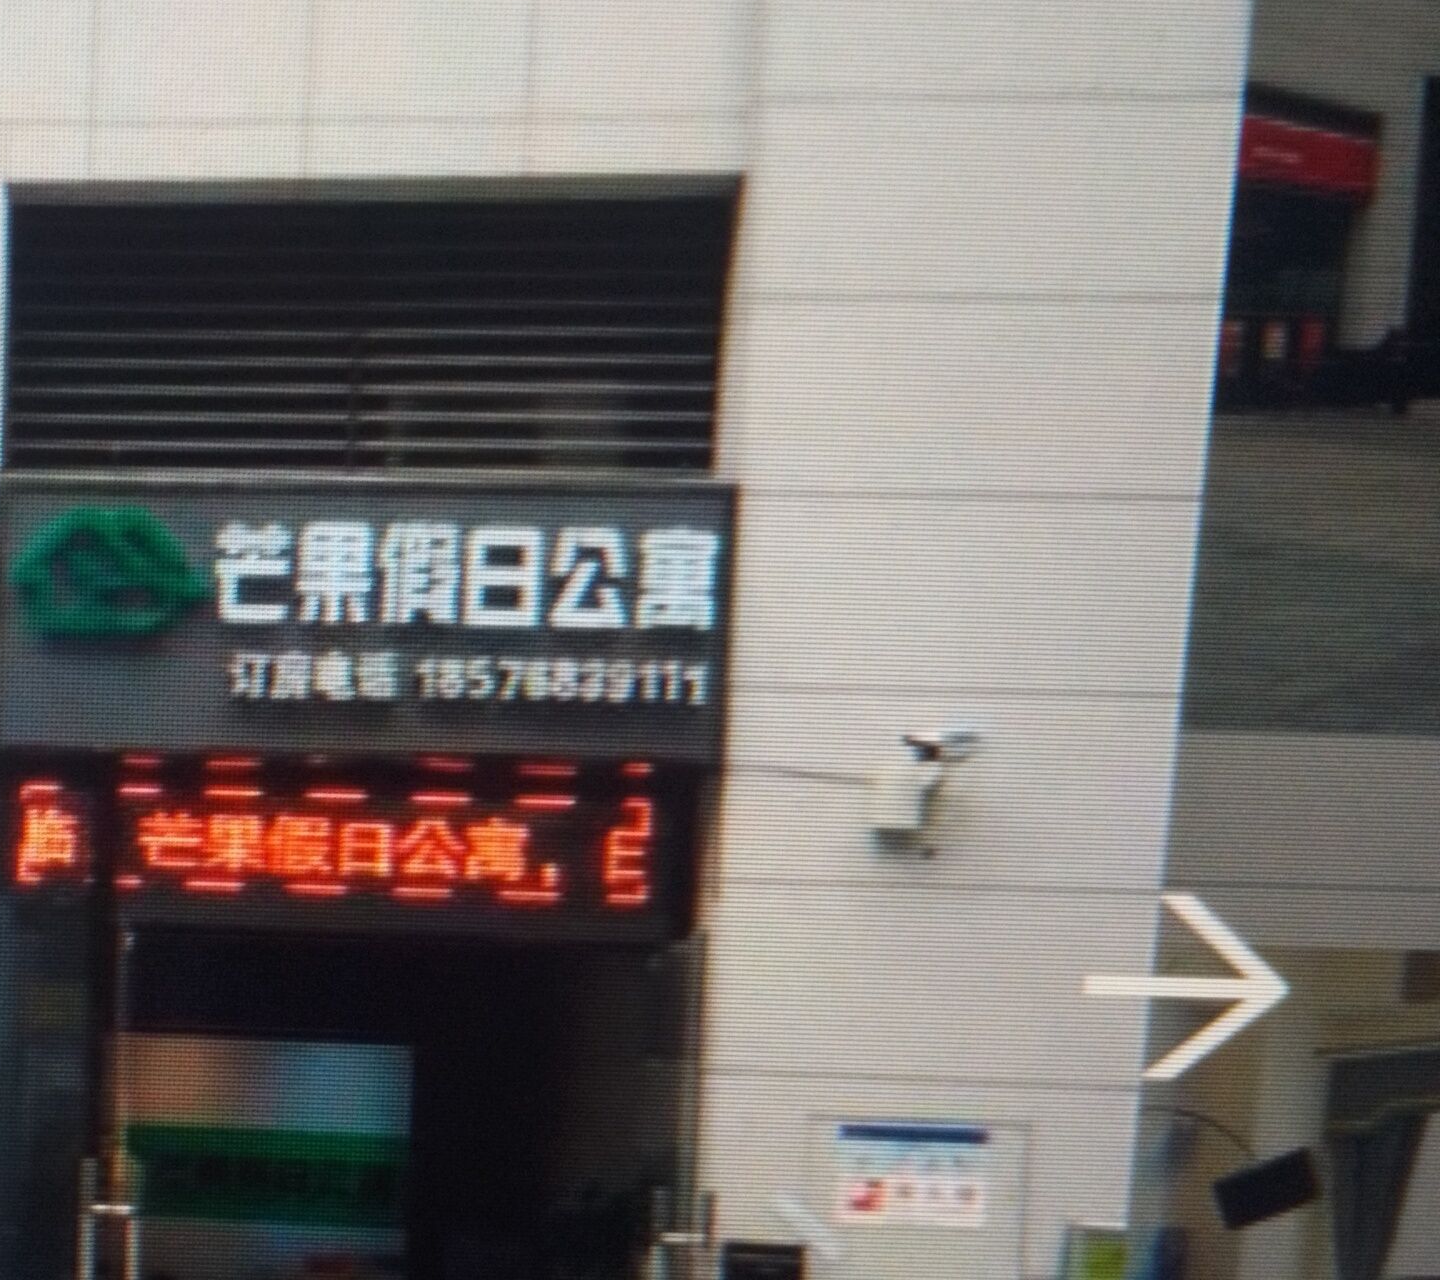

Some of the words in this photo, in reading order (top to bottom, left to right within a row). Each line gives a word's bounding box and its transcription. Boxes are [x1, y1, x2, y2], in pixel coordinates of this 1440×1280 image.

[212, 519, 723, 631] 芒果假日公寓
